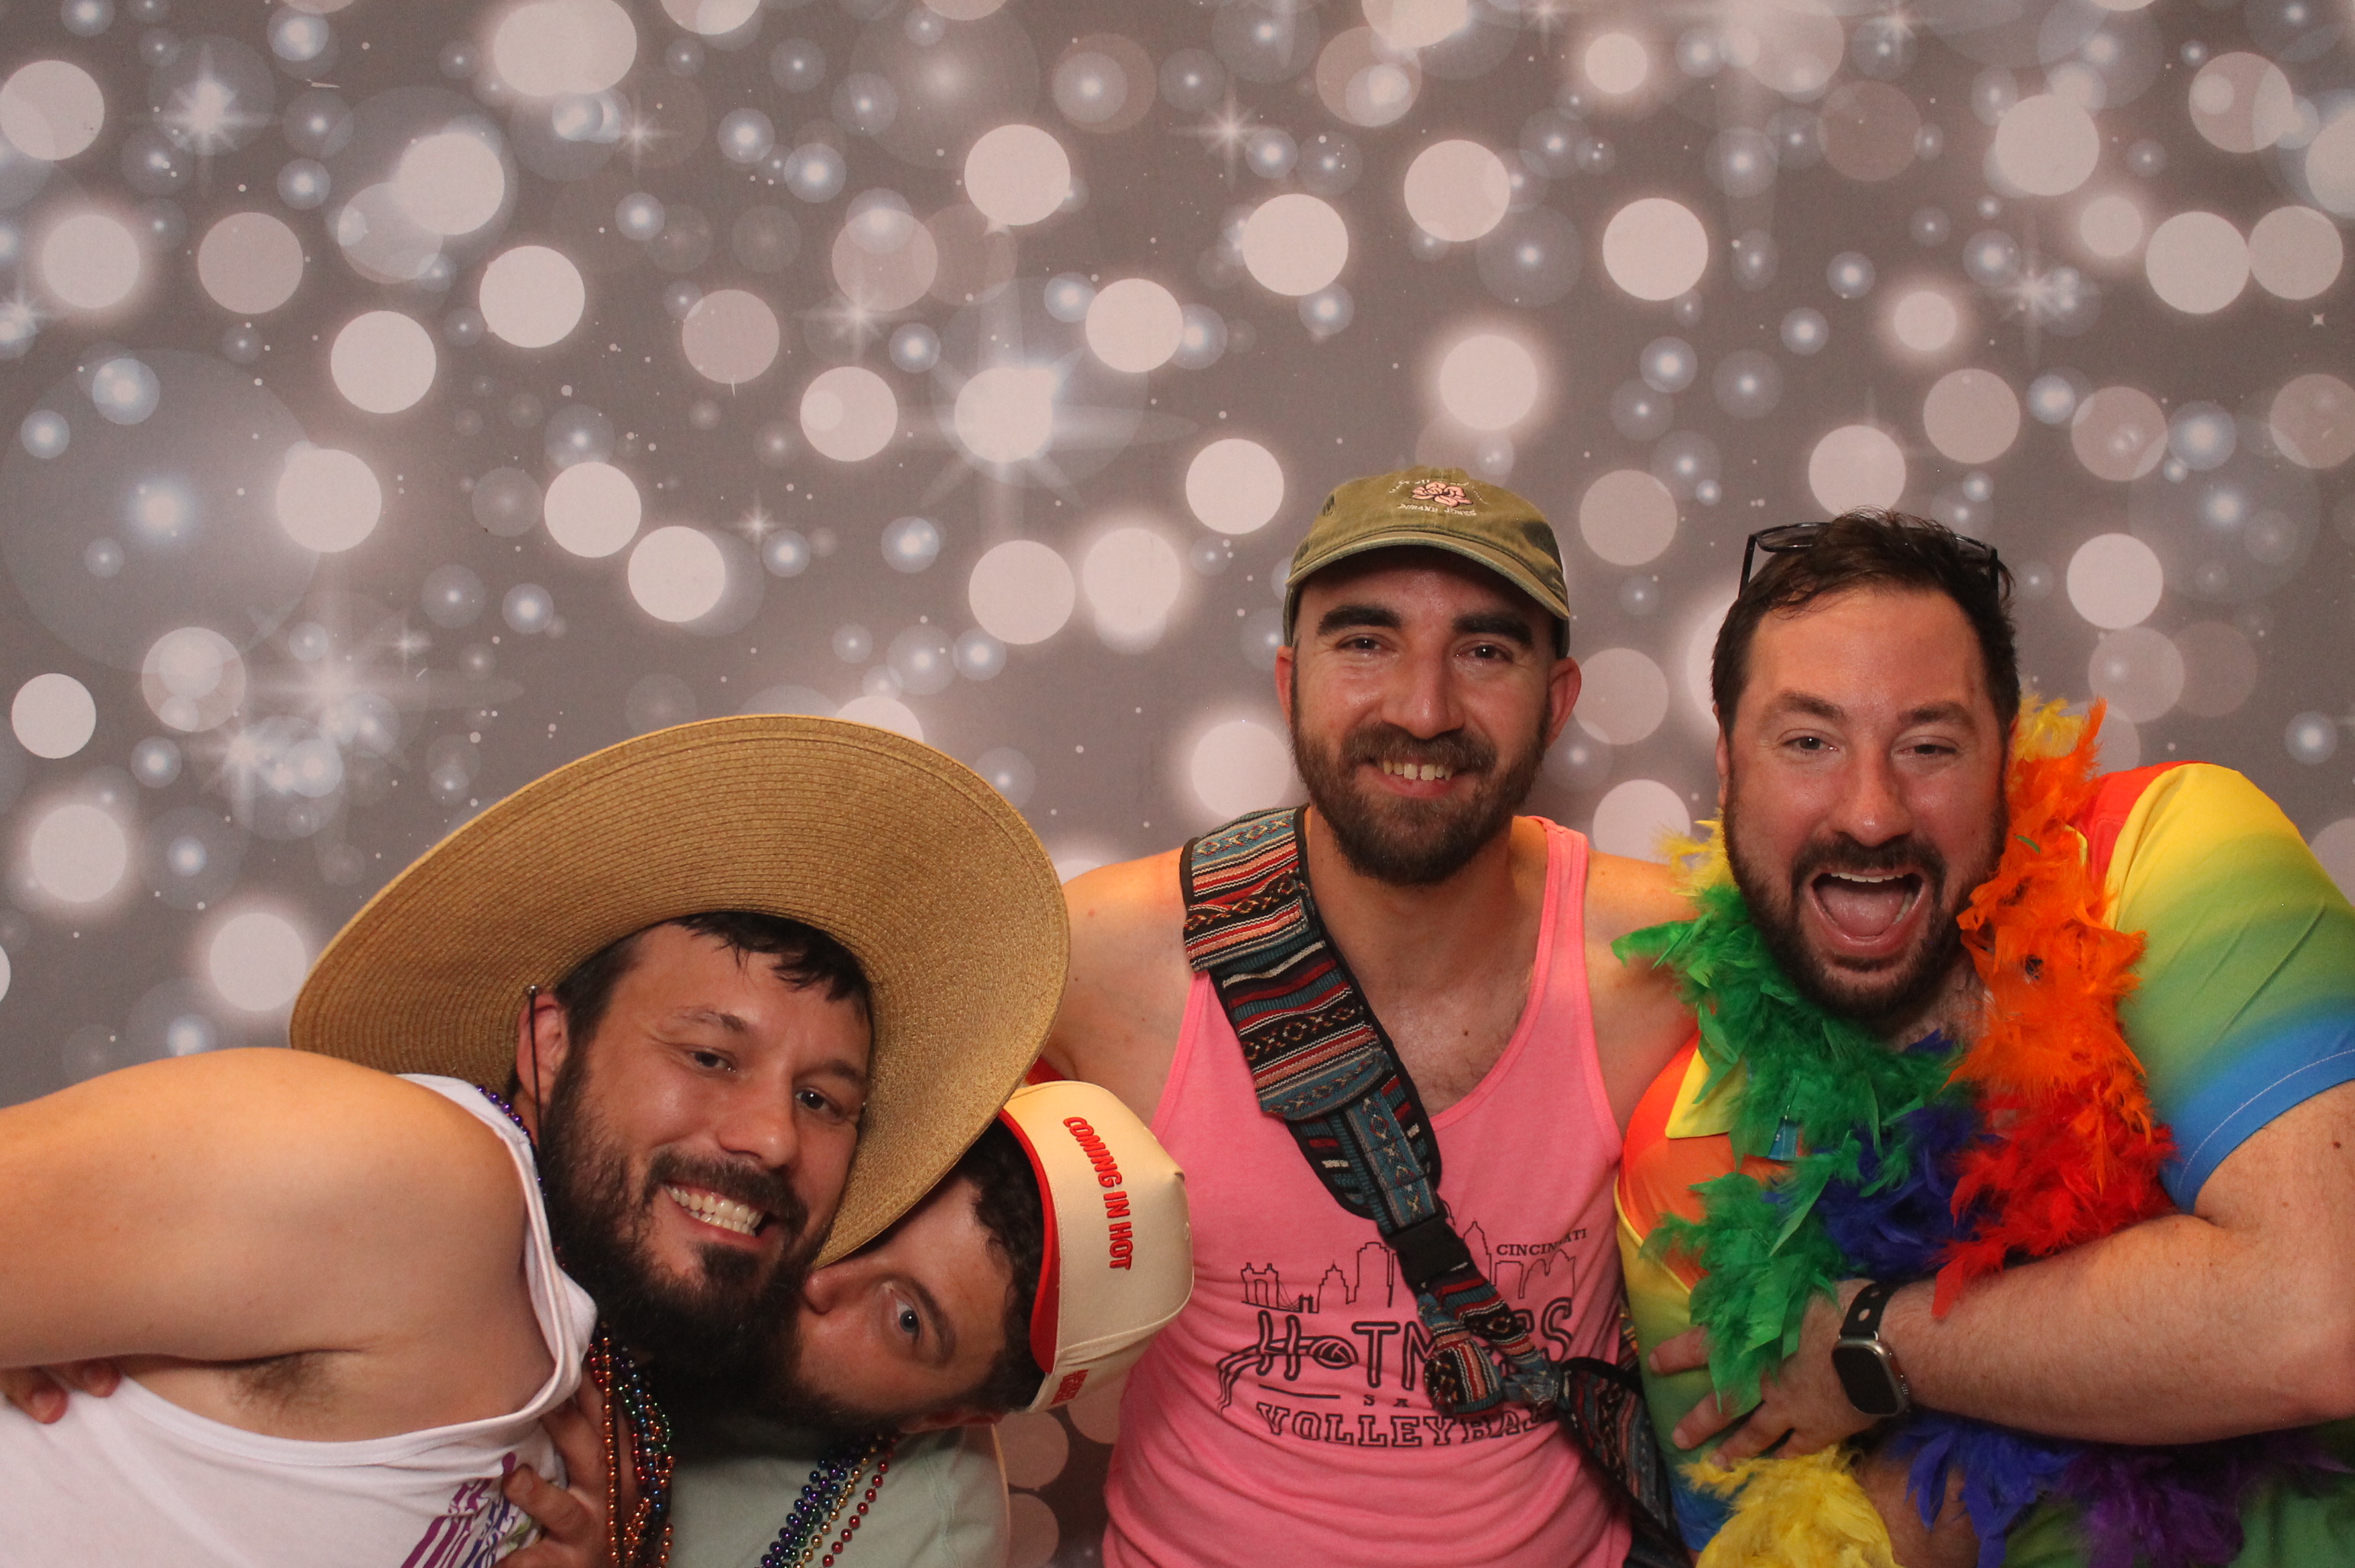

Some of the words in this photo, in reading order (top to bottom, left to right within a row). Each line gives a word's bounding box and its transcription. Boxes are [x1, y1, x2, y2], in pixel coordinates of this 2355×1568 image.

[1063, 1116, 1123, 1188] COMING
[1104, 1190, 1130, 1219] IN
[1109, 1221, 1133, 1271] HOT
[1496, 1228, 1588, 1256] CINCINATI
[1255, 1401, 1551, 1448] VOLLEYBAL
